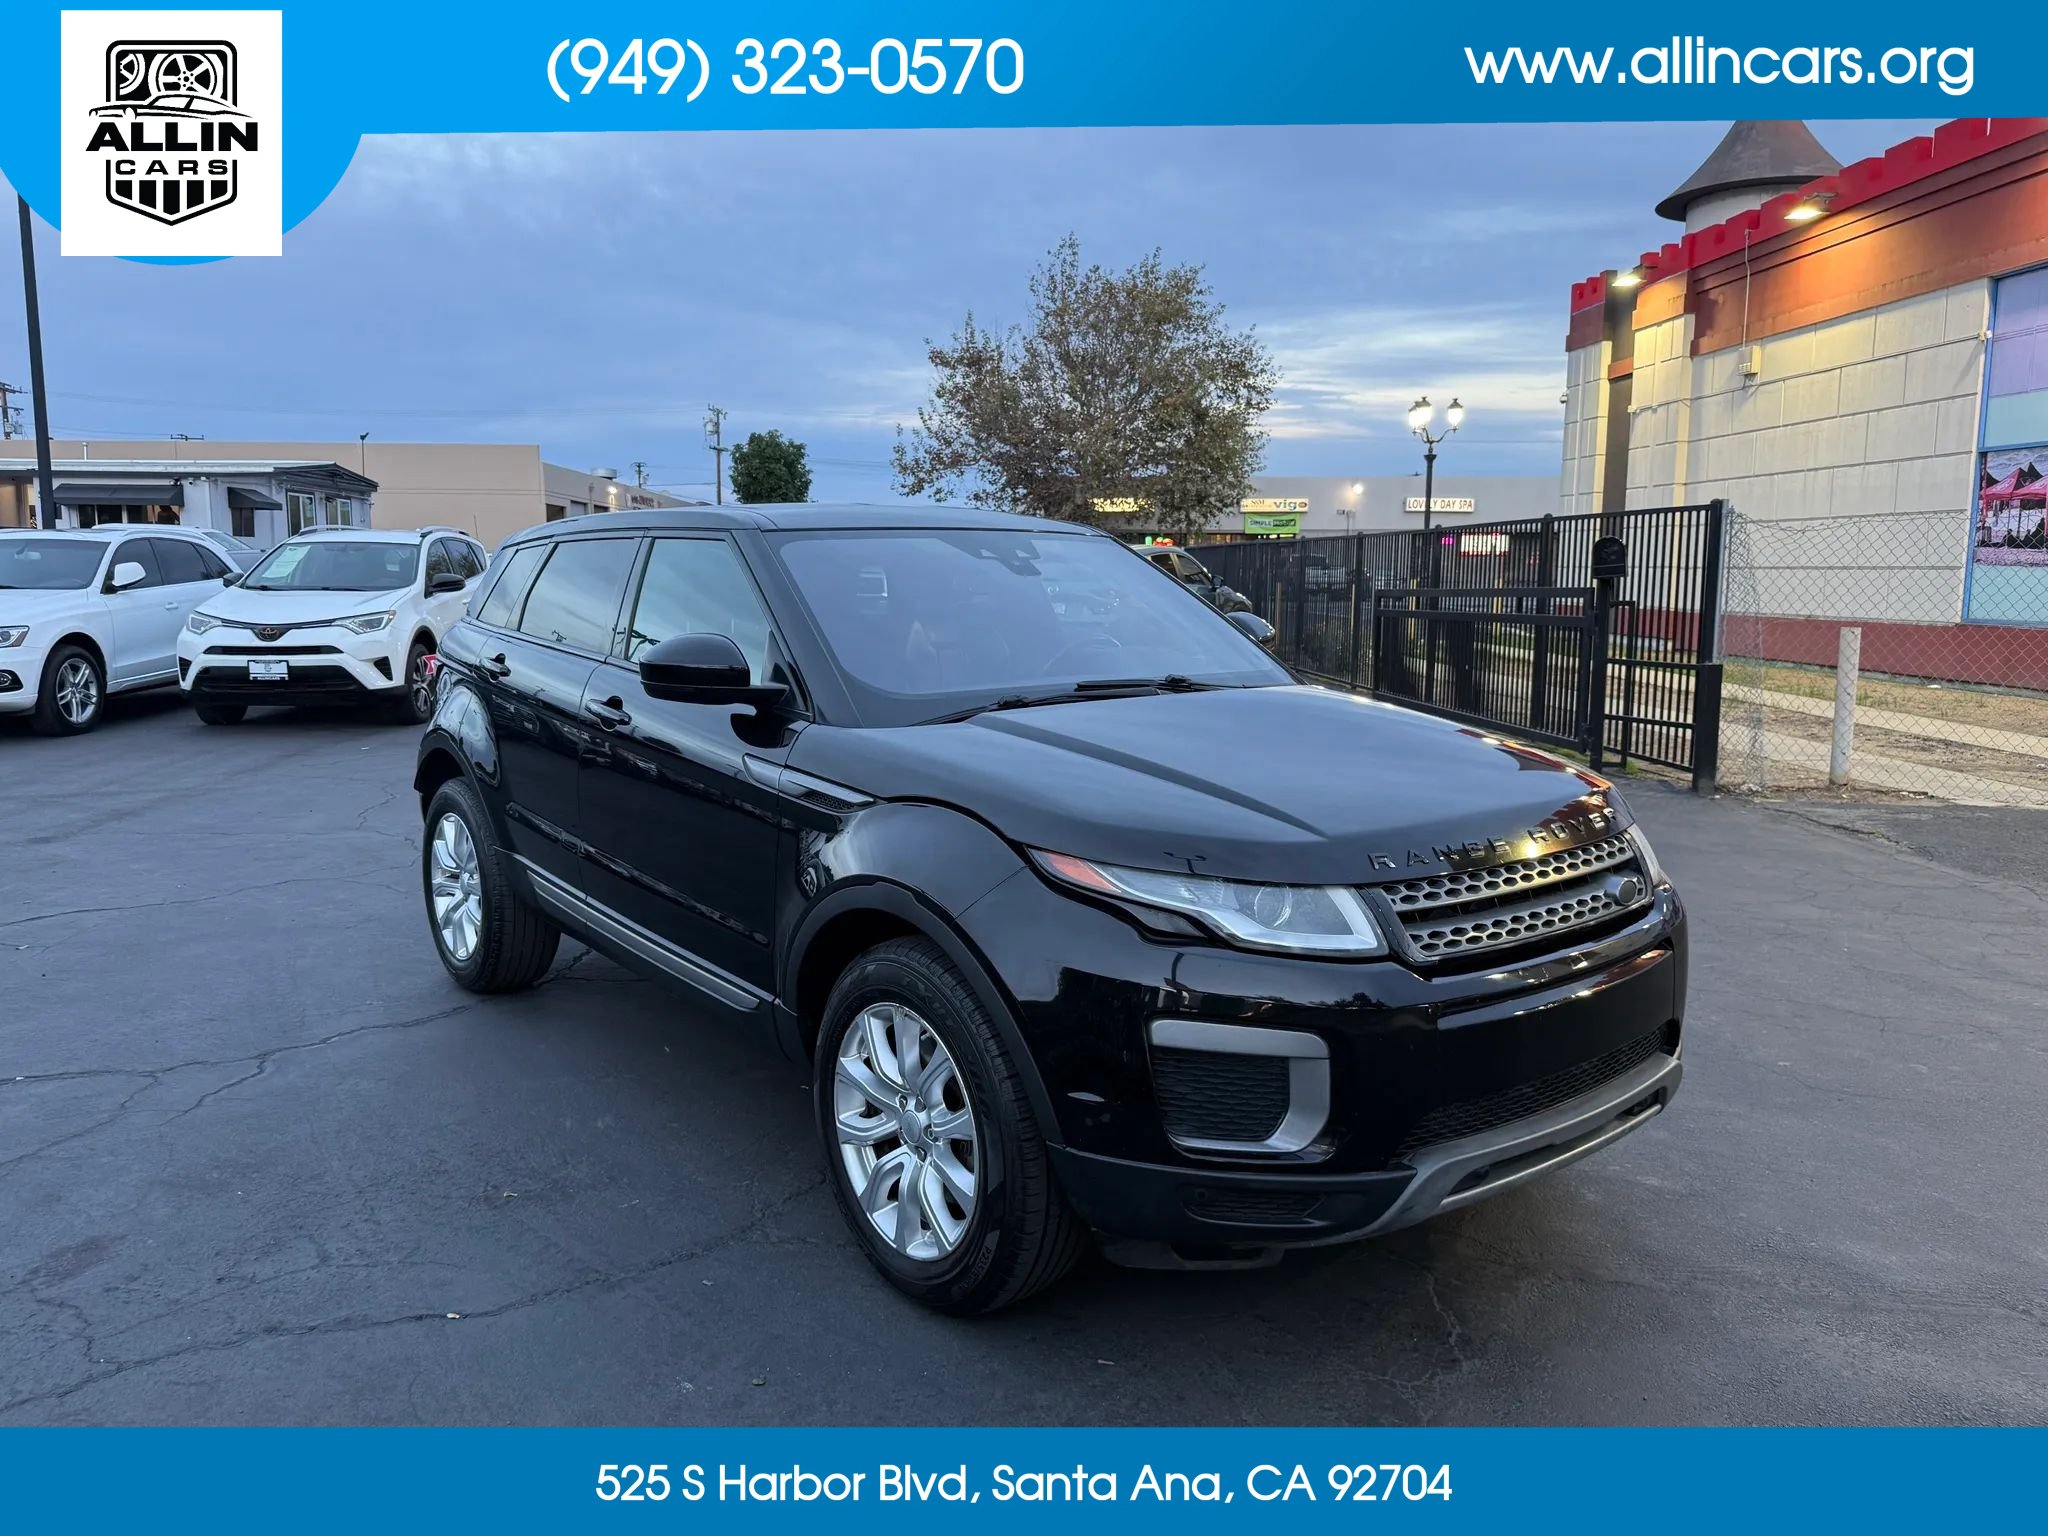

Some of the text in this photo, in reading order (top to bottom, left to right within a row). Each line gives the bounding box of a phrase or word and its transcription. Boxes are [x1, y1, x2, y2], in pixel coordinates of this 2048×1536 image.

[1408, 499, 1473, 510] LOVY DAY SPA
[1367, 807, 1617, 870] RANGE ROVER
